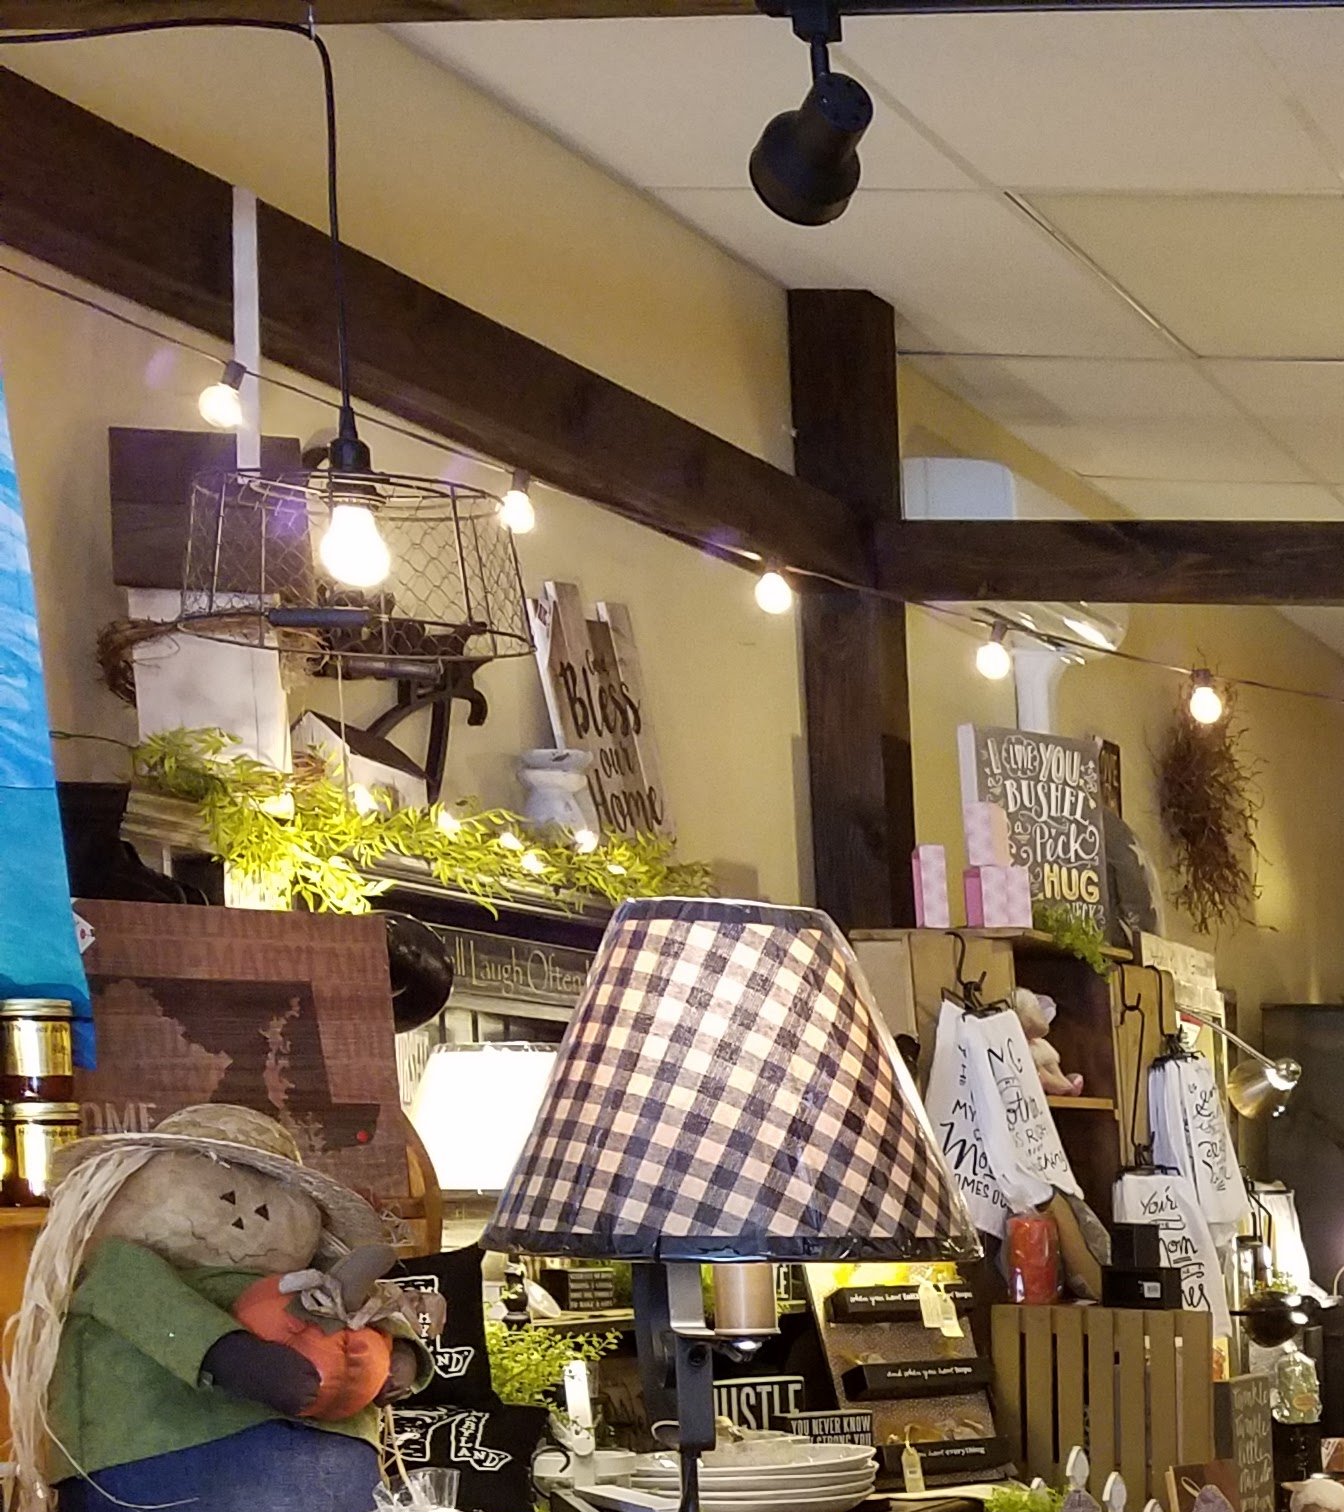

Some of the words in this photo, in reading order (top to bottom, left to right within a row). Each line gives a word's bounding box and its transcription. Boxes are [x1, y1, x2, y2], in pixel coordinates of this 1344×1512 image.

[560, 662, 641, 739] Bless
[600, 742, 635, 778] our
[1039, 743, 1081, 787] YOU
[587, 768, 665, 833] Home
[1004, 780, 1090, 827] BUSHEL
[1043, 863, 1100, 903] HUG
[470, 940, 523, 996] Laugh
[527, 950, 582, 994] Often
[812, 1416, 841, 1435] NEVER
[843, 1414, 871, 1433] KNOW
